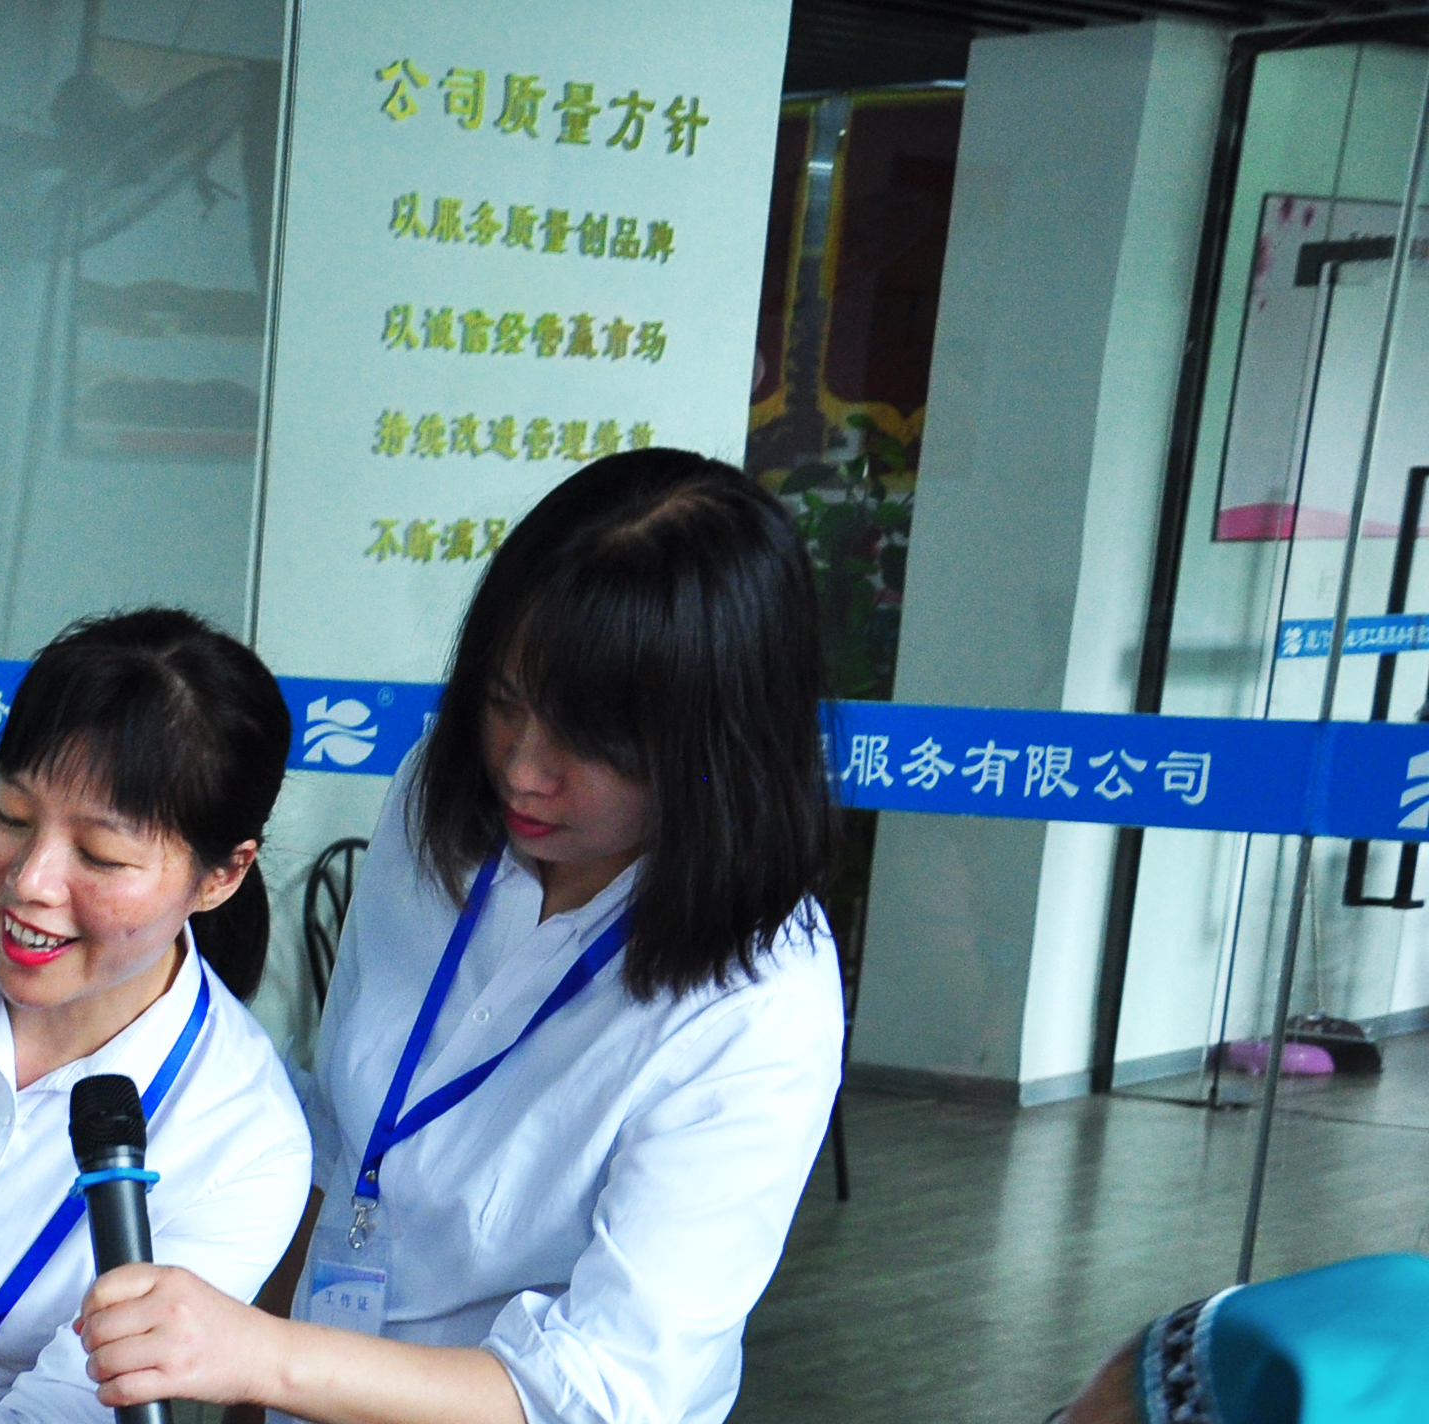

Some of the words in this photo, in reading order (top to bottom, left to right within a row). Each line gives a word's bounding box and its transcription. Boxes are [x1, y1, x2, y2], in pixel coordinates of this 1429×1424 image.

[375, 58, 711, 157] 公司质量方针
[388, 190, 676, 266] 以服务质量创品牌
[380, 302, 669, 364] 以诚信经营赢市场
[819, 732, 1213, 806] 服务有限公司
